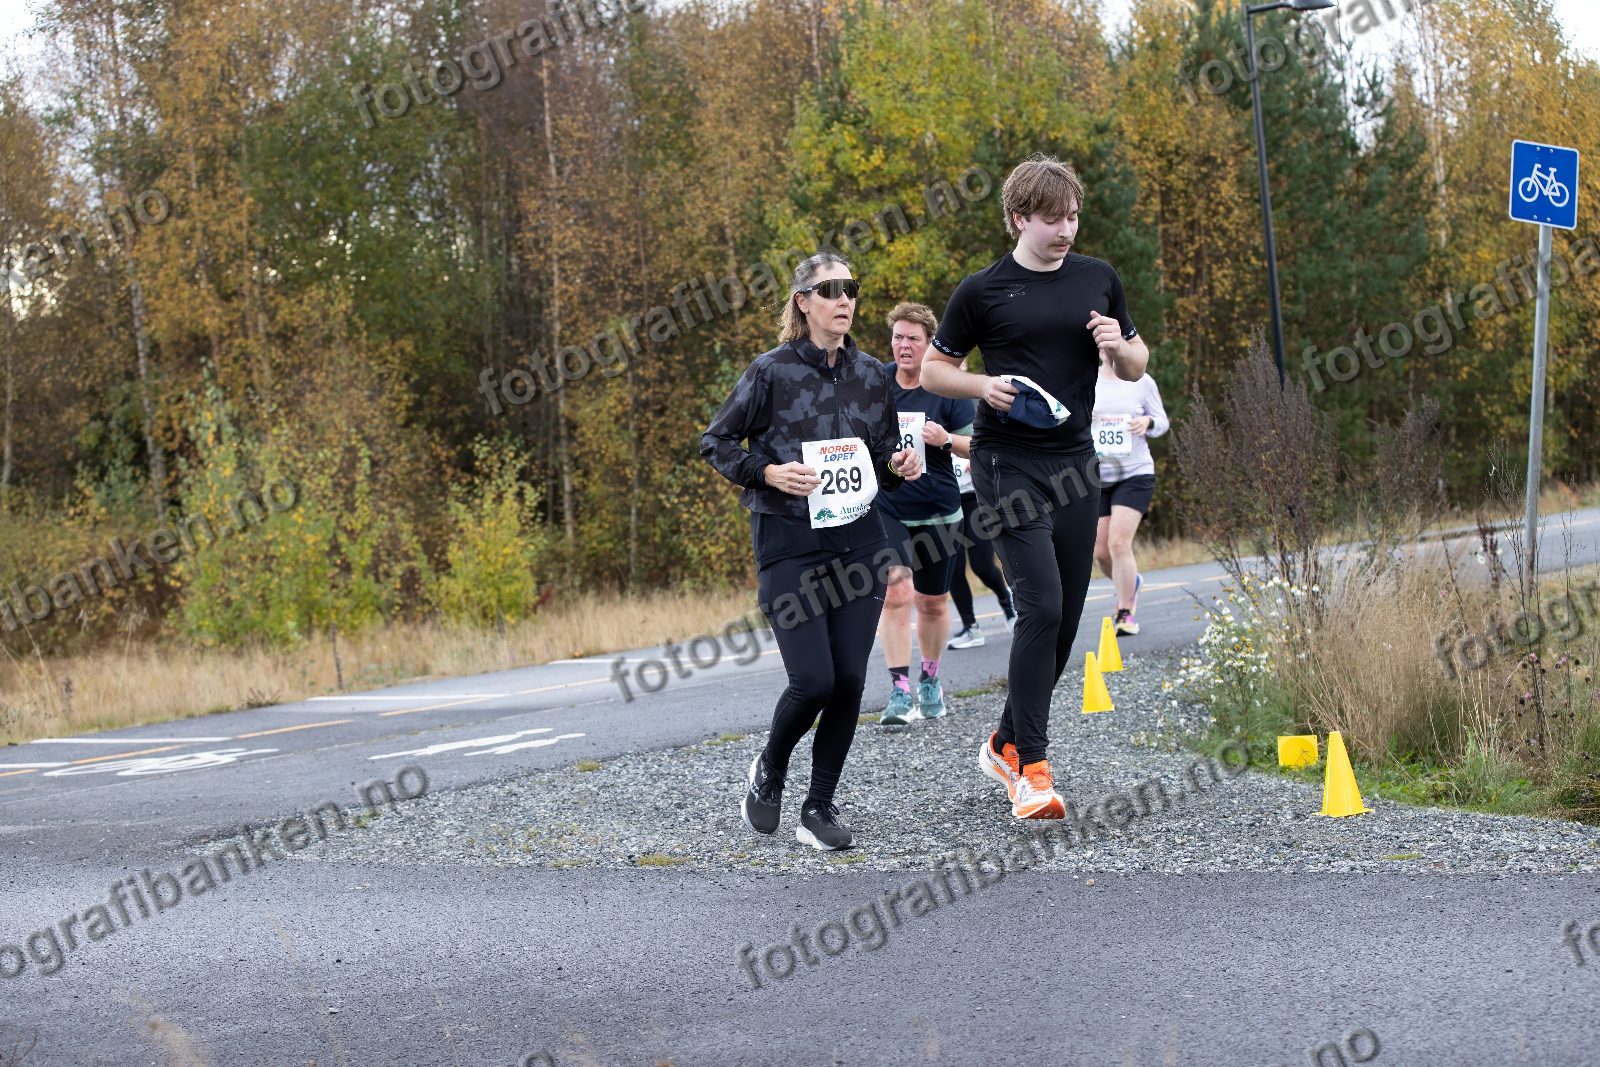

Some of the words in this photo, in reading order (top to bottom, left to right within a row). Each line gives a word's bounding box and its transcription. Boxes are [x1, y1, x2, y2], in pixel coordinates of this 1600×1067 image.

[1099, 430, 1124, 445] 835
[819, 444, 858, 455] NORGES
[824, 452, 855, 463] LØPET
[820, 466, 862, 496] 269
